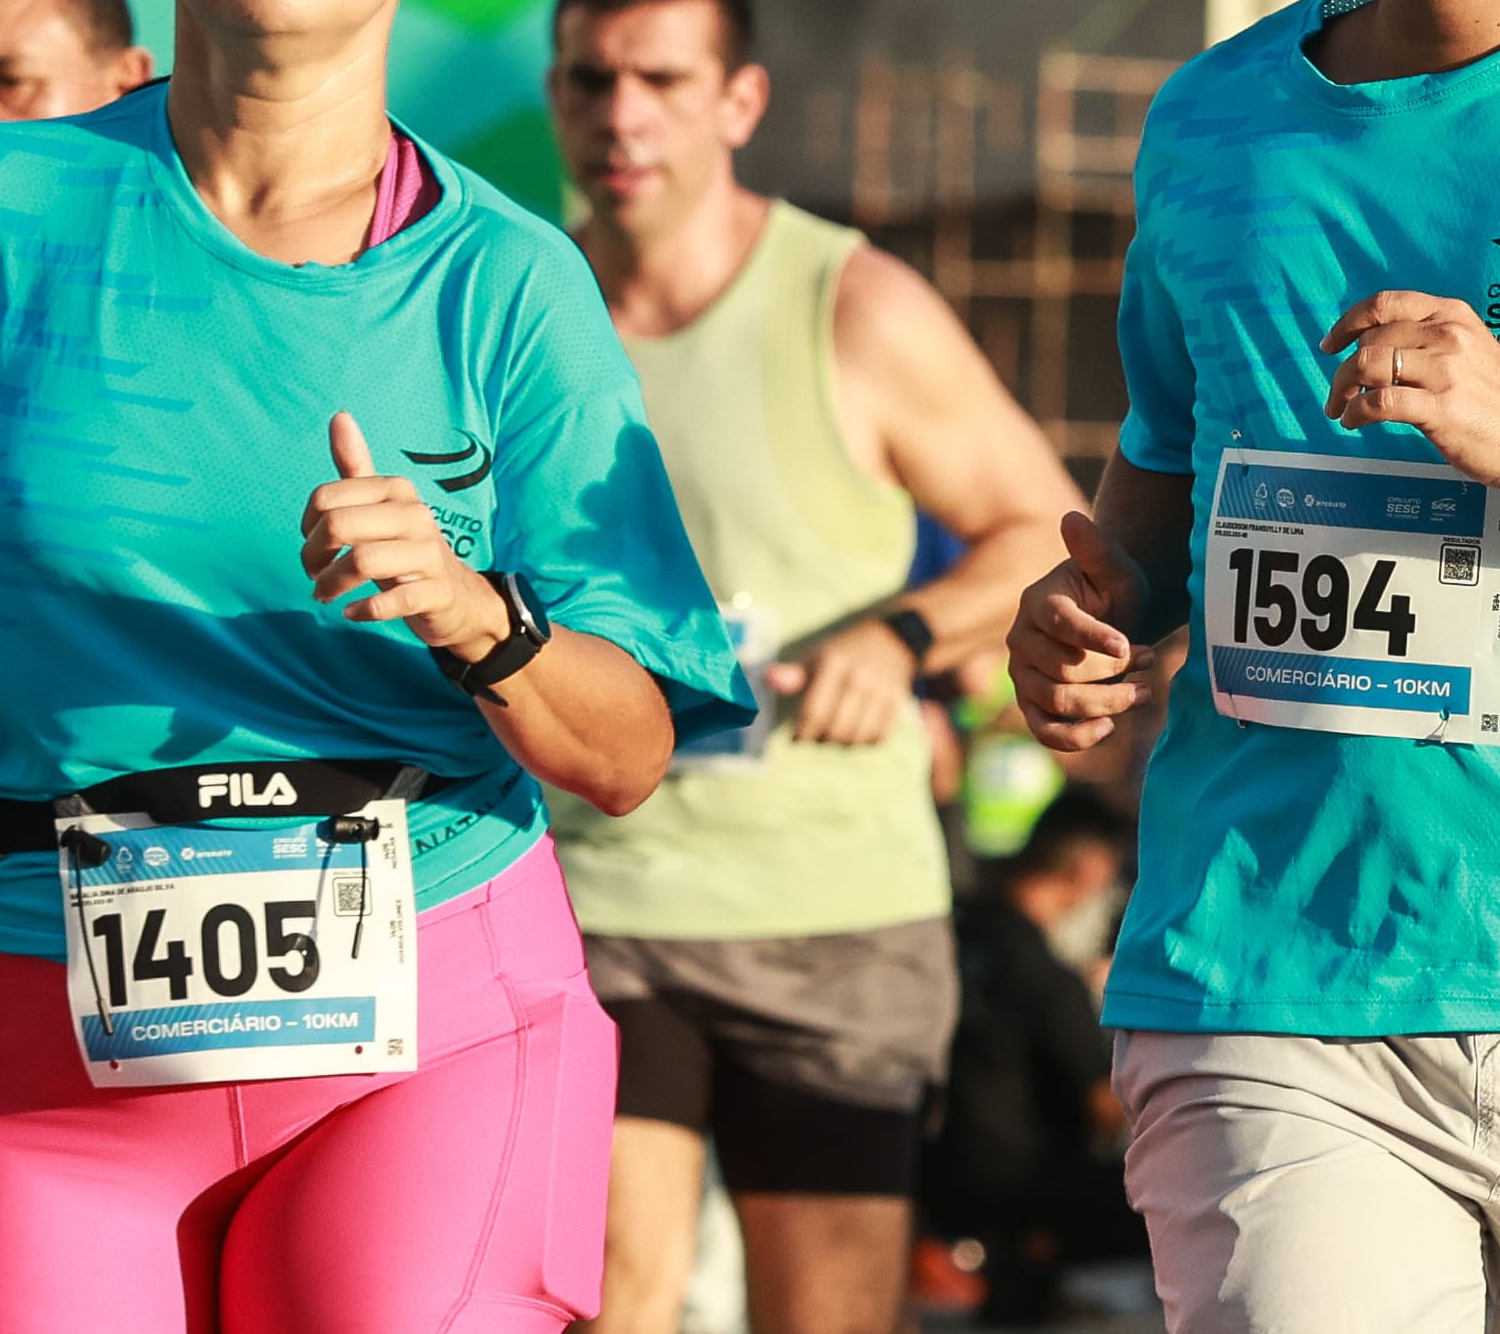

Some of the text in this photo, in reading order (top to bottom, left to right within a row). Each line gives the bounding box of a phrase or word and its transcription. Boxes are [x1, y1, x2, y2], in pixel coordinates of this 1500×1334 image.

[1386, 503, 1421, 515] SESC
[1229, 548, 1416, 657] 1594
[1245, 665, 1372, 692] COMERCIÁRIO
[1393, 677, 1451, 698] 10KM
[198, 772, 298, 808] FILA
[93, 900, 320, 1007] 1405
[131, 1012, 281, 1041] COMERCIÁRIO
[303, 1012, 358, 1030] 10KM
